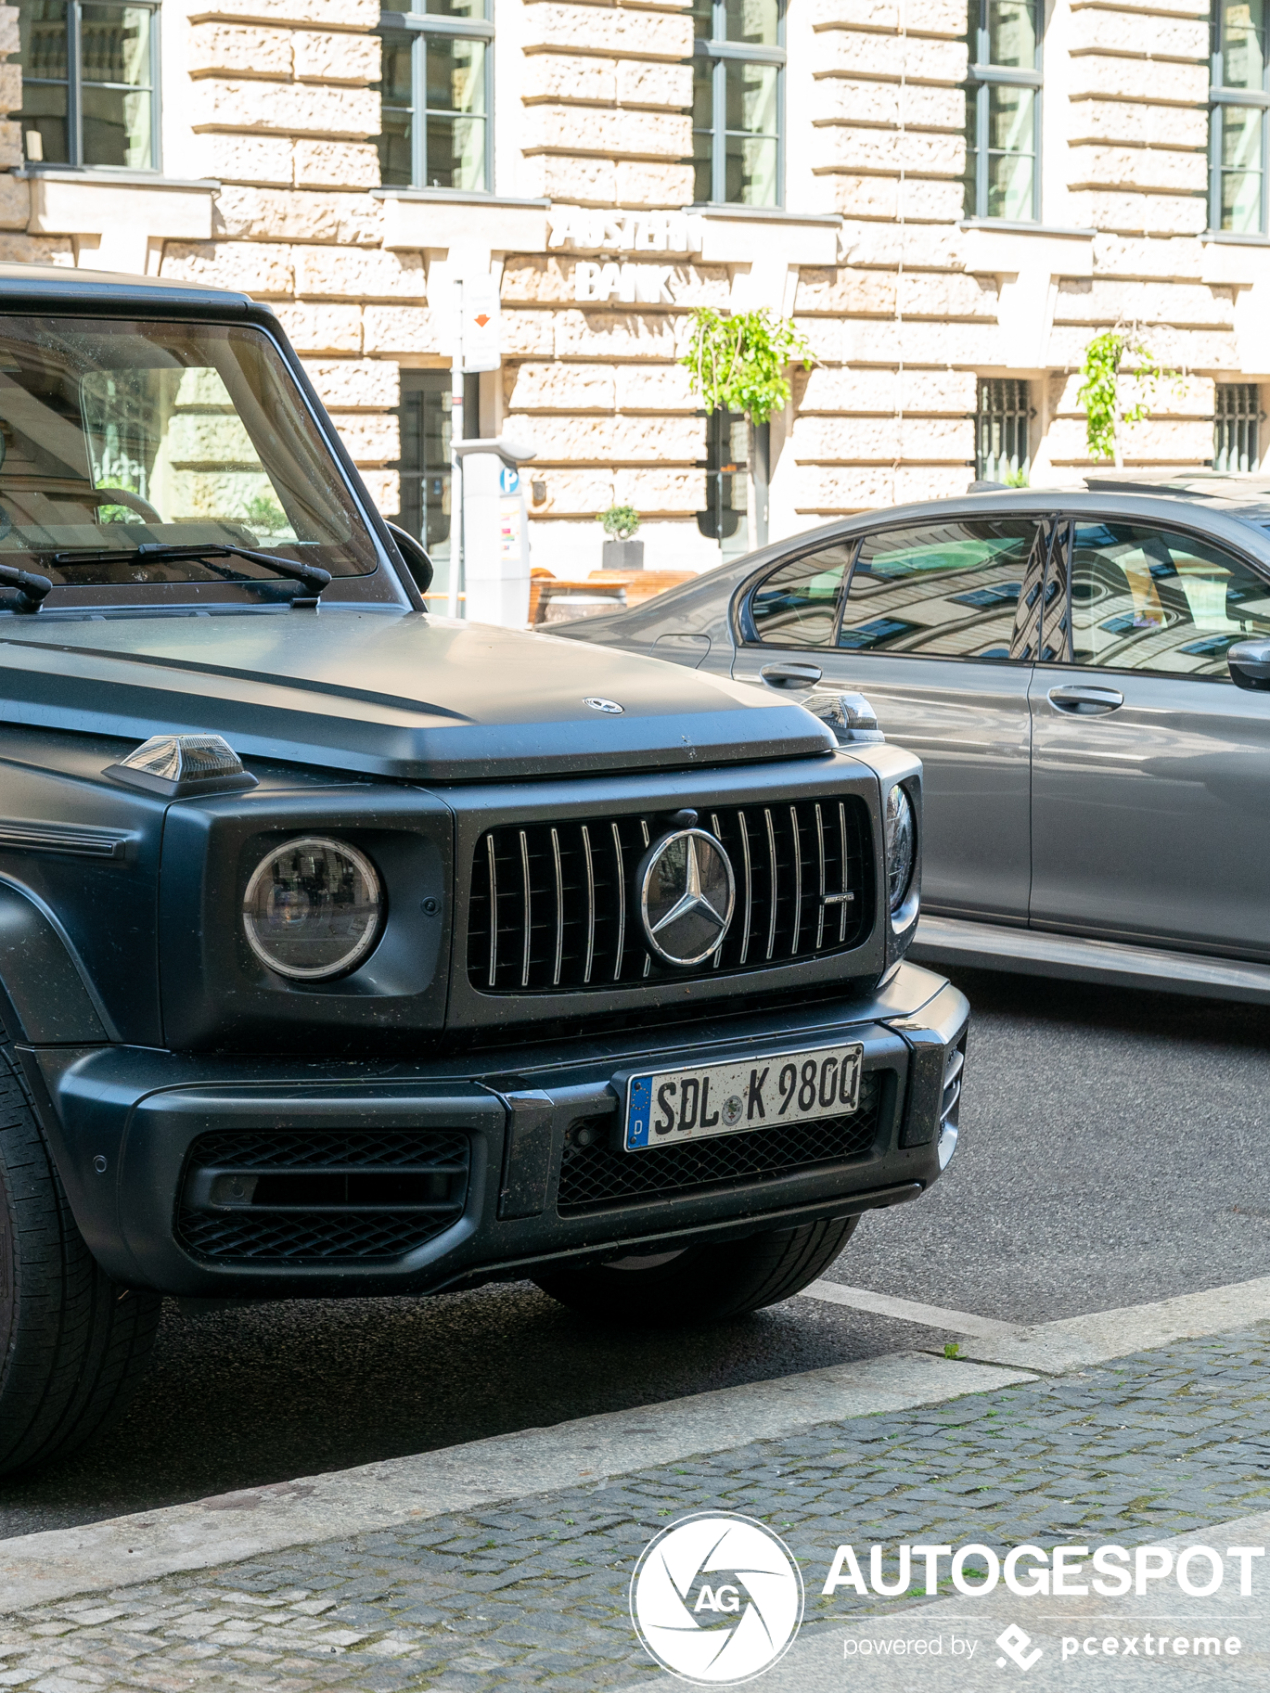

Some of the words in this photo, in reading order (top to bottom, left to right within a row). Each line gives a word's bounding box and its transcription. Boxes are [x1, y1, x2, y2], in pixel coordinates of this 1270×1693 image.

[575, 262, 675, 304] BANK
[655, 1077, 720, 1135] SDL
[747, 1067, 770, 1120] K
[778, 1054, 858, 1115] 9800
[633, 1119, 644, 1136] D
